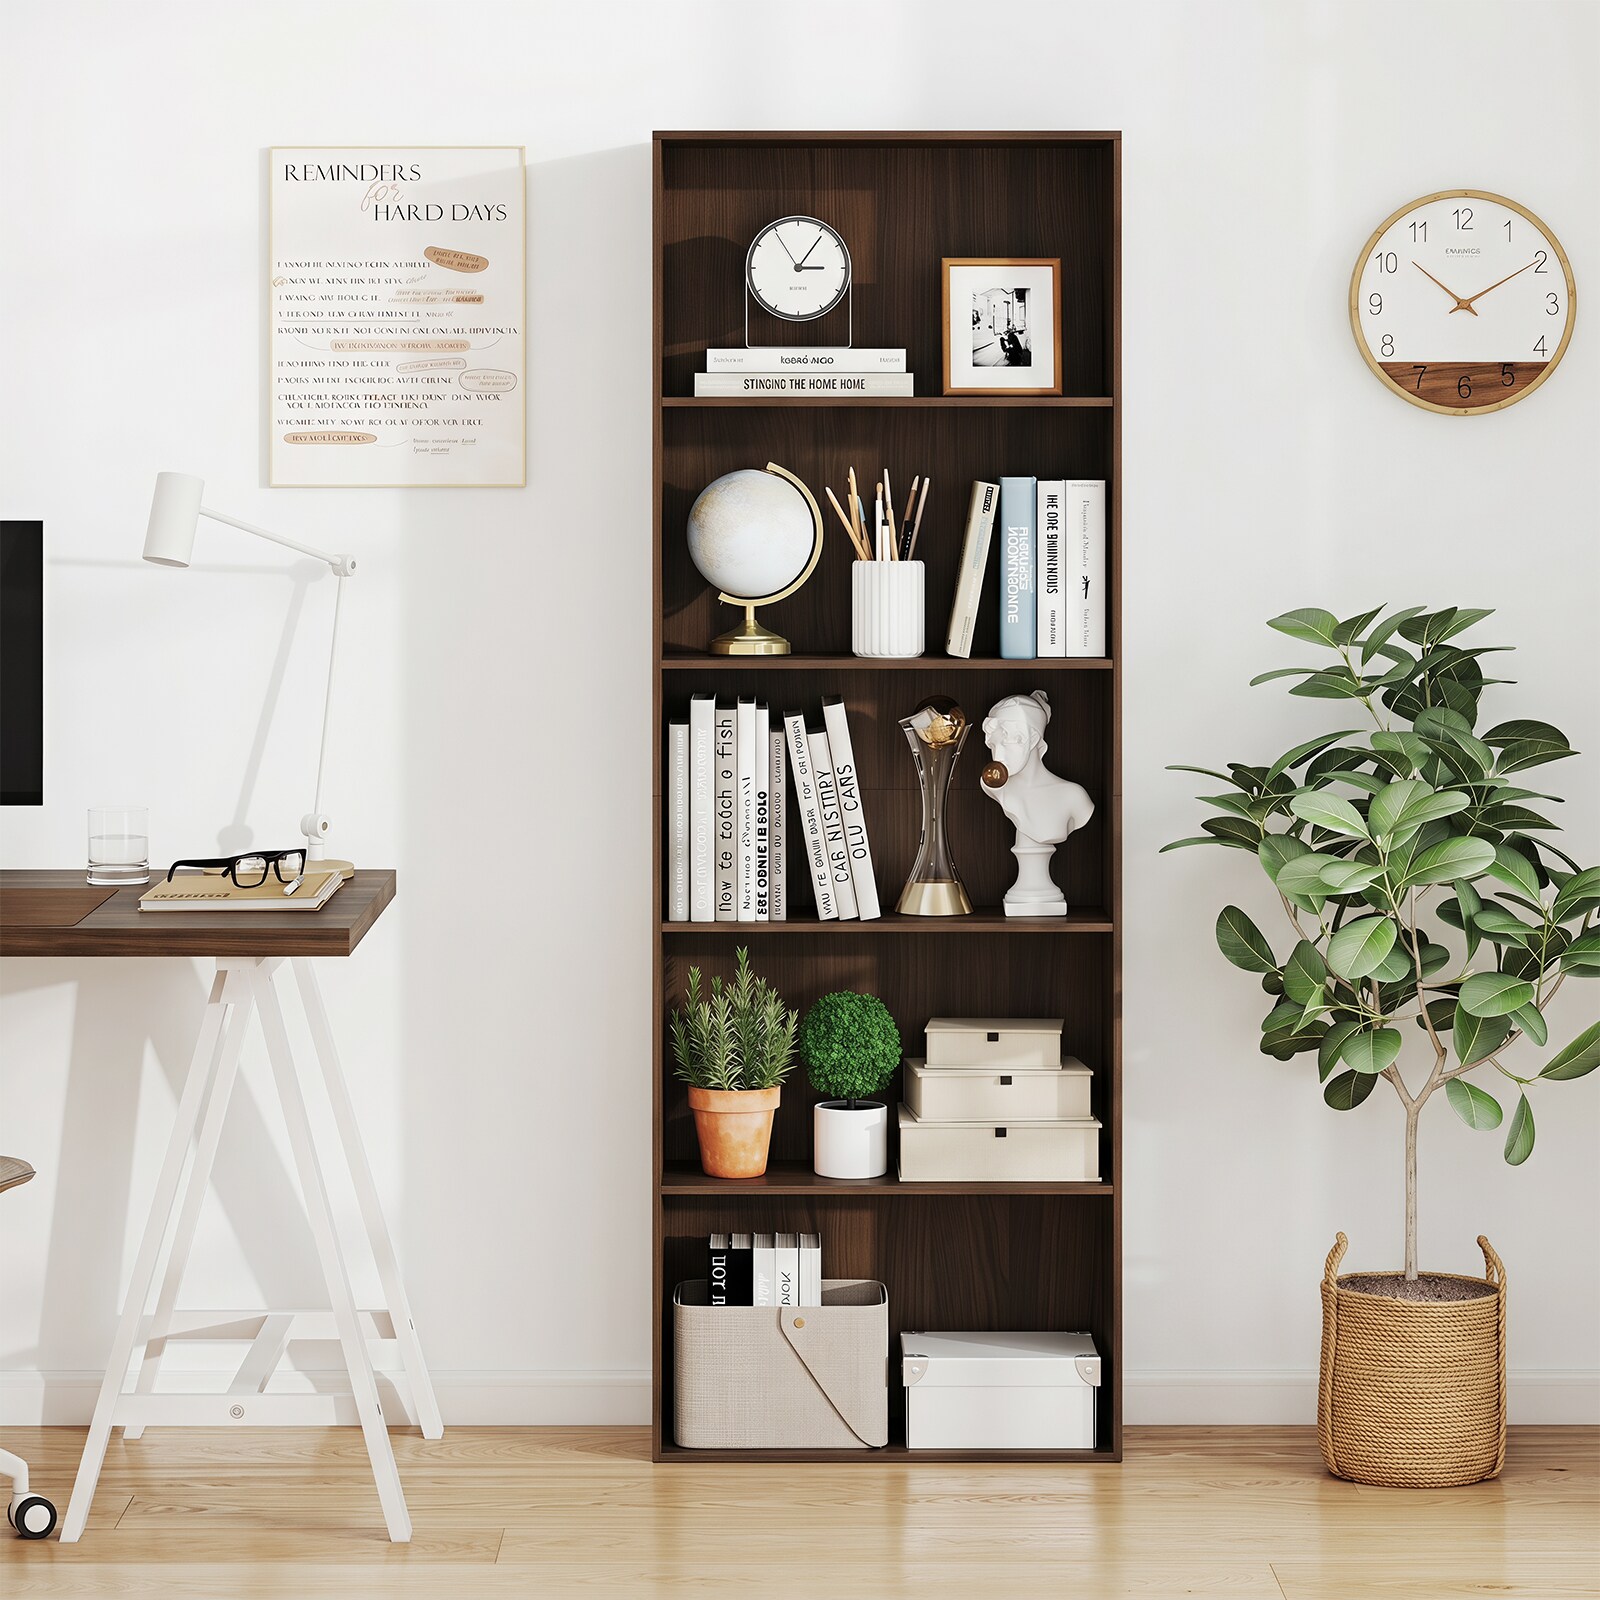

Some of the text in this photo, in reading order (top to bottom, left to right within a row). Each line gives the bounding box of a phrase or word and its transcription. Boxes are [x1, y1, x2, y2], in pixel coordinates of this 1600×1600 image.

[284, 163, 422, 182] REMINDERS
[360, 180, 404, 212] for
[374, 203, 508, 222] HARD DAYS
[1451, 207, 1474, 231] 12
[1408, 220, 1428, 243] 11
[1502, 219, 1513, 243] 1
[1374, 251, 1399, 275] 10
[1533, 250, 1549, 275] 2
[1368, 292, 1384, 316] 9
[1545, 292, 1560, 316] 3
[1380, 333, 1395, 358] 8
[1532, 334, 1549, 358] 4
[789, 377, 807, 390] THE
[808, 377, 838, 391] HOME
[840, 377, 866, 391] HOME
[1412, 365, 1428, 390] 7
[1456, 375, 1472, 399] 6
[1500, 363, 1515, 387] 5
[716, 718, 733, 759] fish
